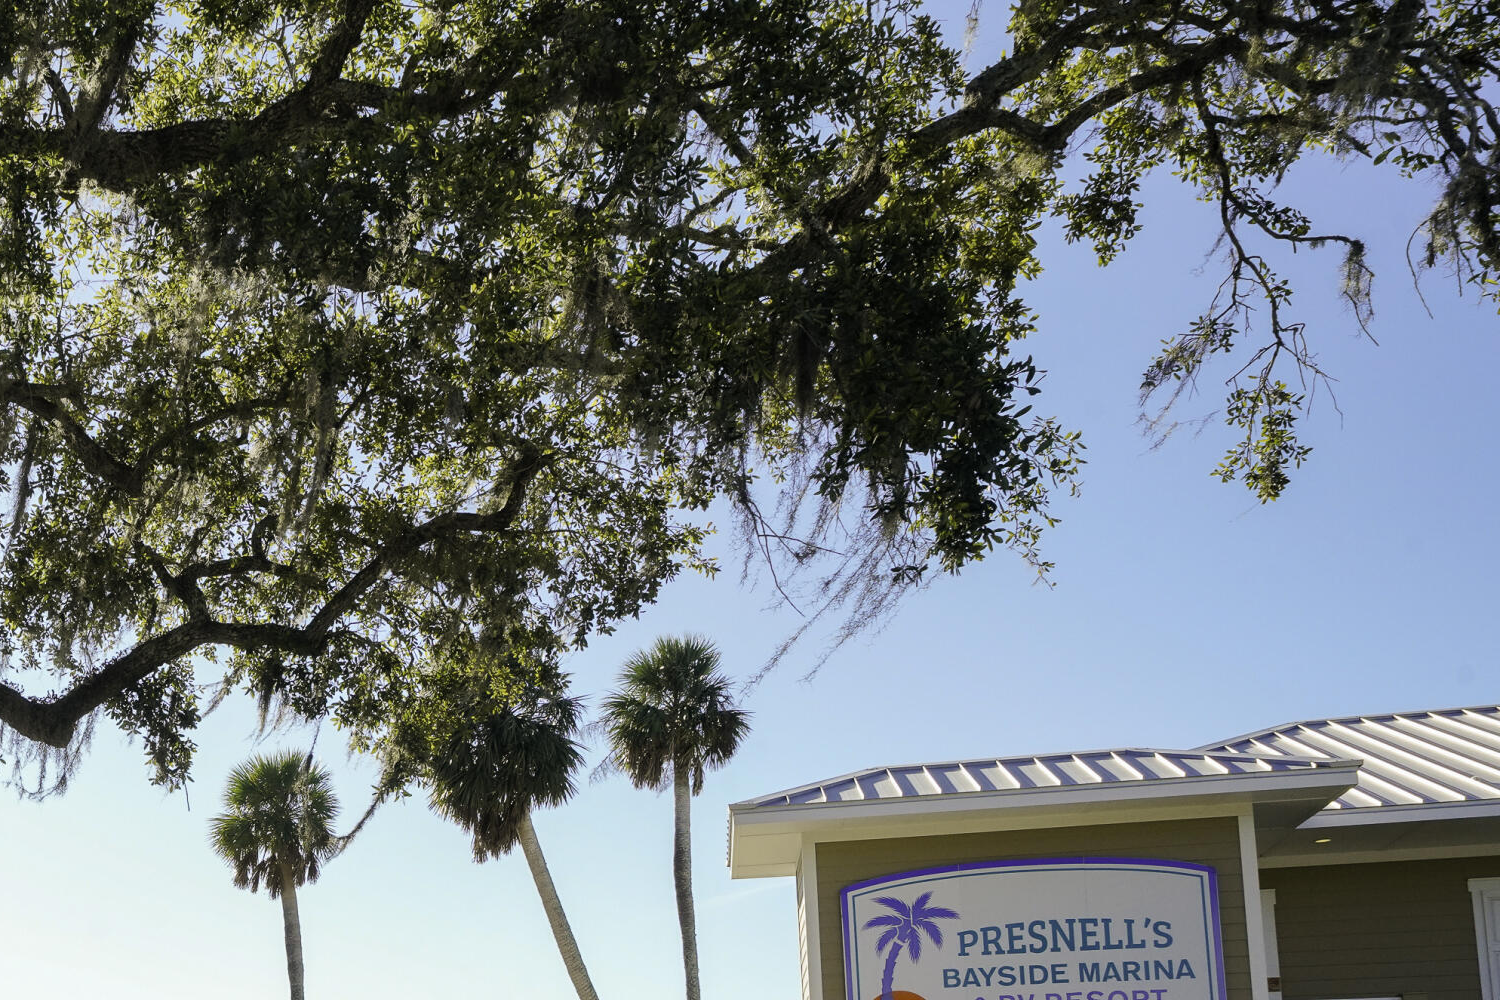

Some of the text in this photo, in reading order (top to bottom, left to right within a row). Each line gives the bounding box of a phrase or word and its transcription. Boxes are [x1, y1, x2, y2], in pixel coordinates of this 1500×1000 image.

[957, 917, 1173, 956] PRESNELL'S
[942, 958, 1197, 988] BAYSIDE MARINA
